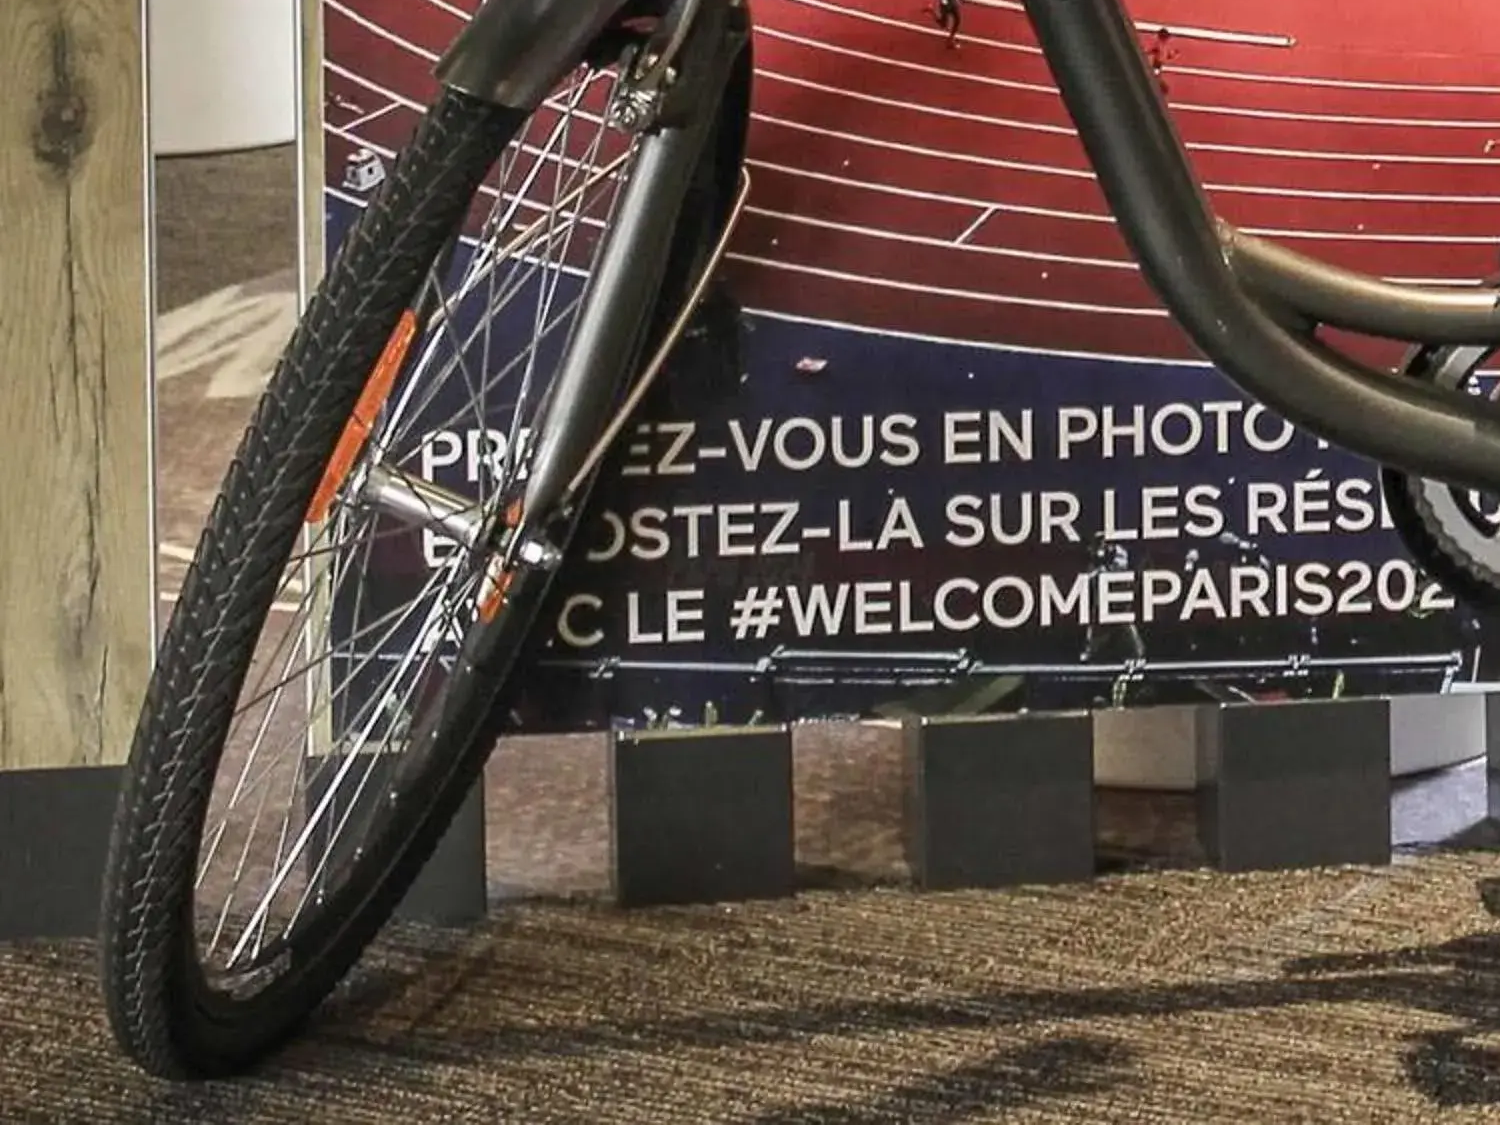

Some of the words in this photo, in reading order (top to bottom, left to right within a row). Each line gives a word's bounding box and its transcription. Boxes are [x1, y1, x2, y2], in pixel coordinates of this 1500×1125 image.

[944, 408, 1033, 465] EN
[1058, 400, 1294, 460] PHOTO
[945, 489, 1081, 547] SUR
[1105, 483, 1224, 542] LES
[627, 589, 705, 644] LE
